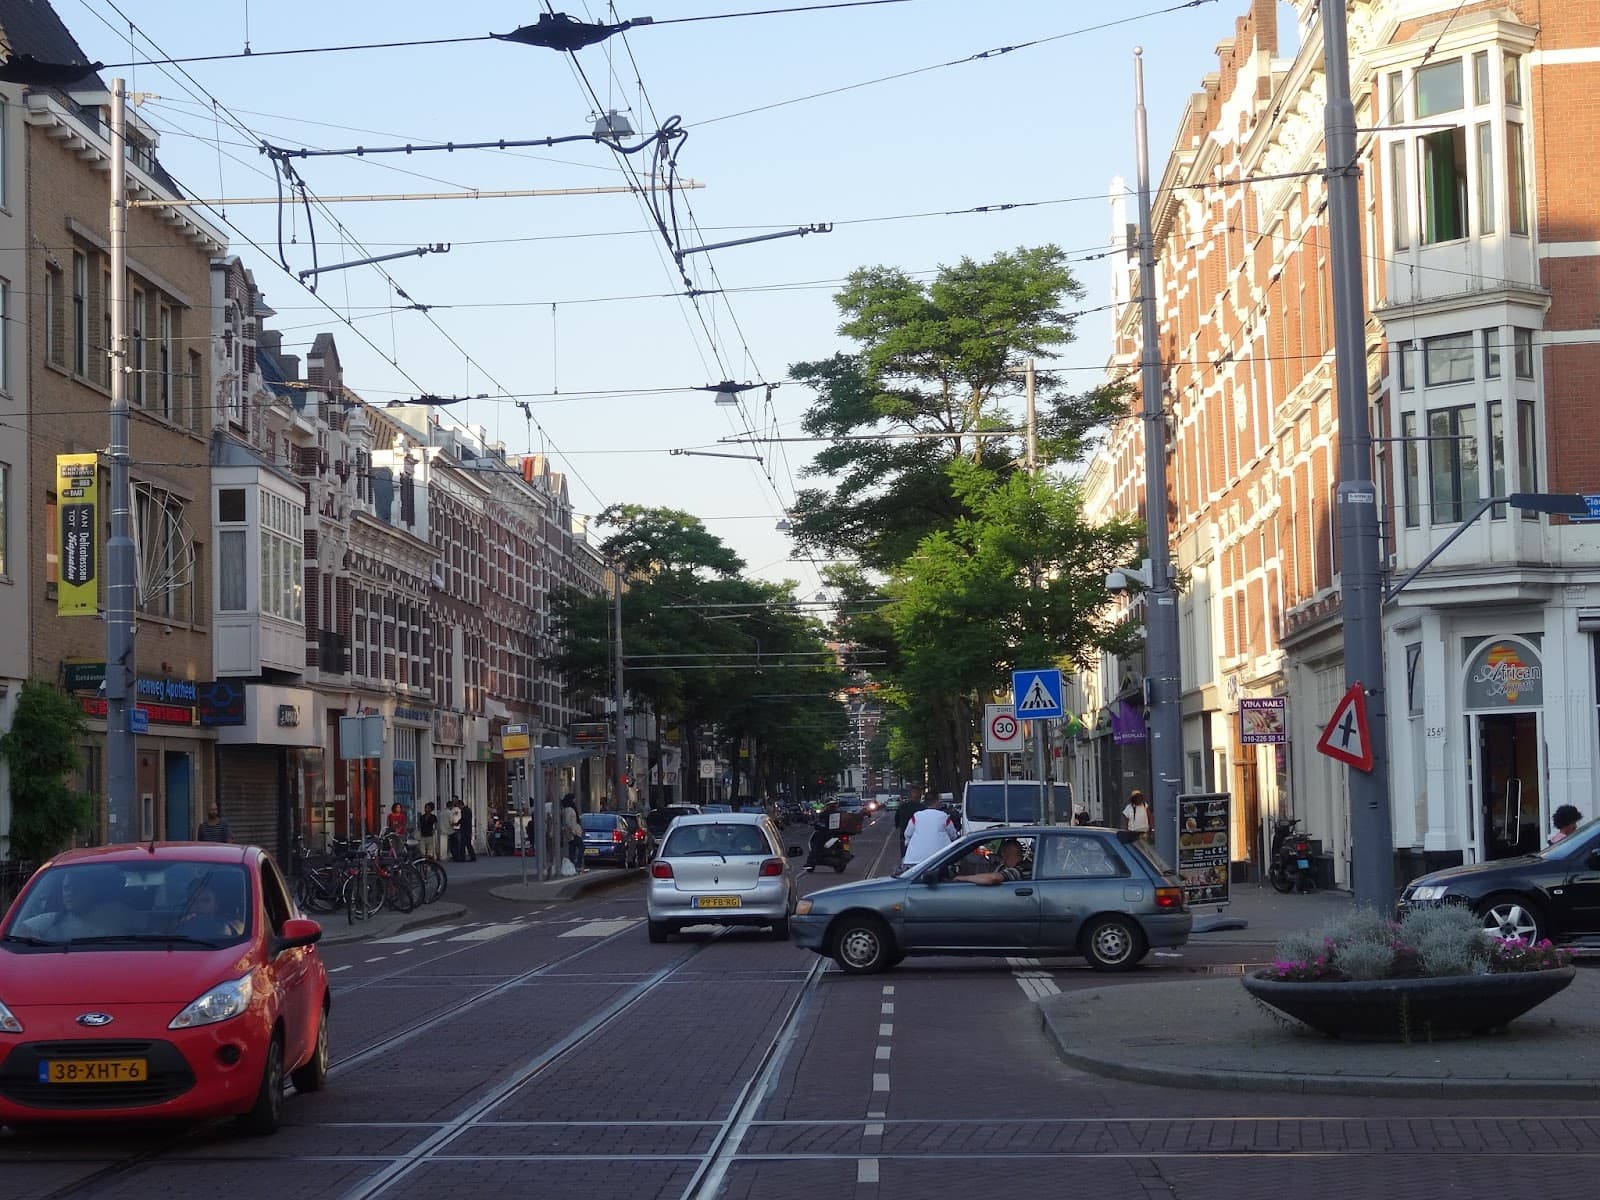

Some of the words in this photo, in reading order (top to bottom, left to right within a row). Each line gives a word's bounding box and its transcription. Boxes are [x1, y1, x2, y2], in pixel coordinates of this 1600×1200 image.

[68, 509, 76, 527] TOT
[1474, 659, 1541, 682] African
[166, 679, 196, 701] Apotheek
[996, 722, 1014, 733] 30
[700, 898, 737, 906] 99-FB-RG
[55, 1063, 140, 1080] 38-XHT-6
